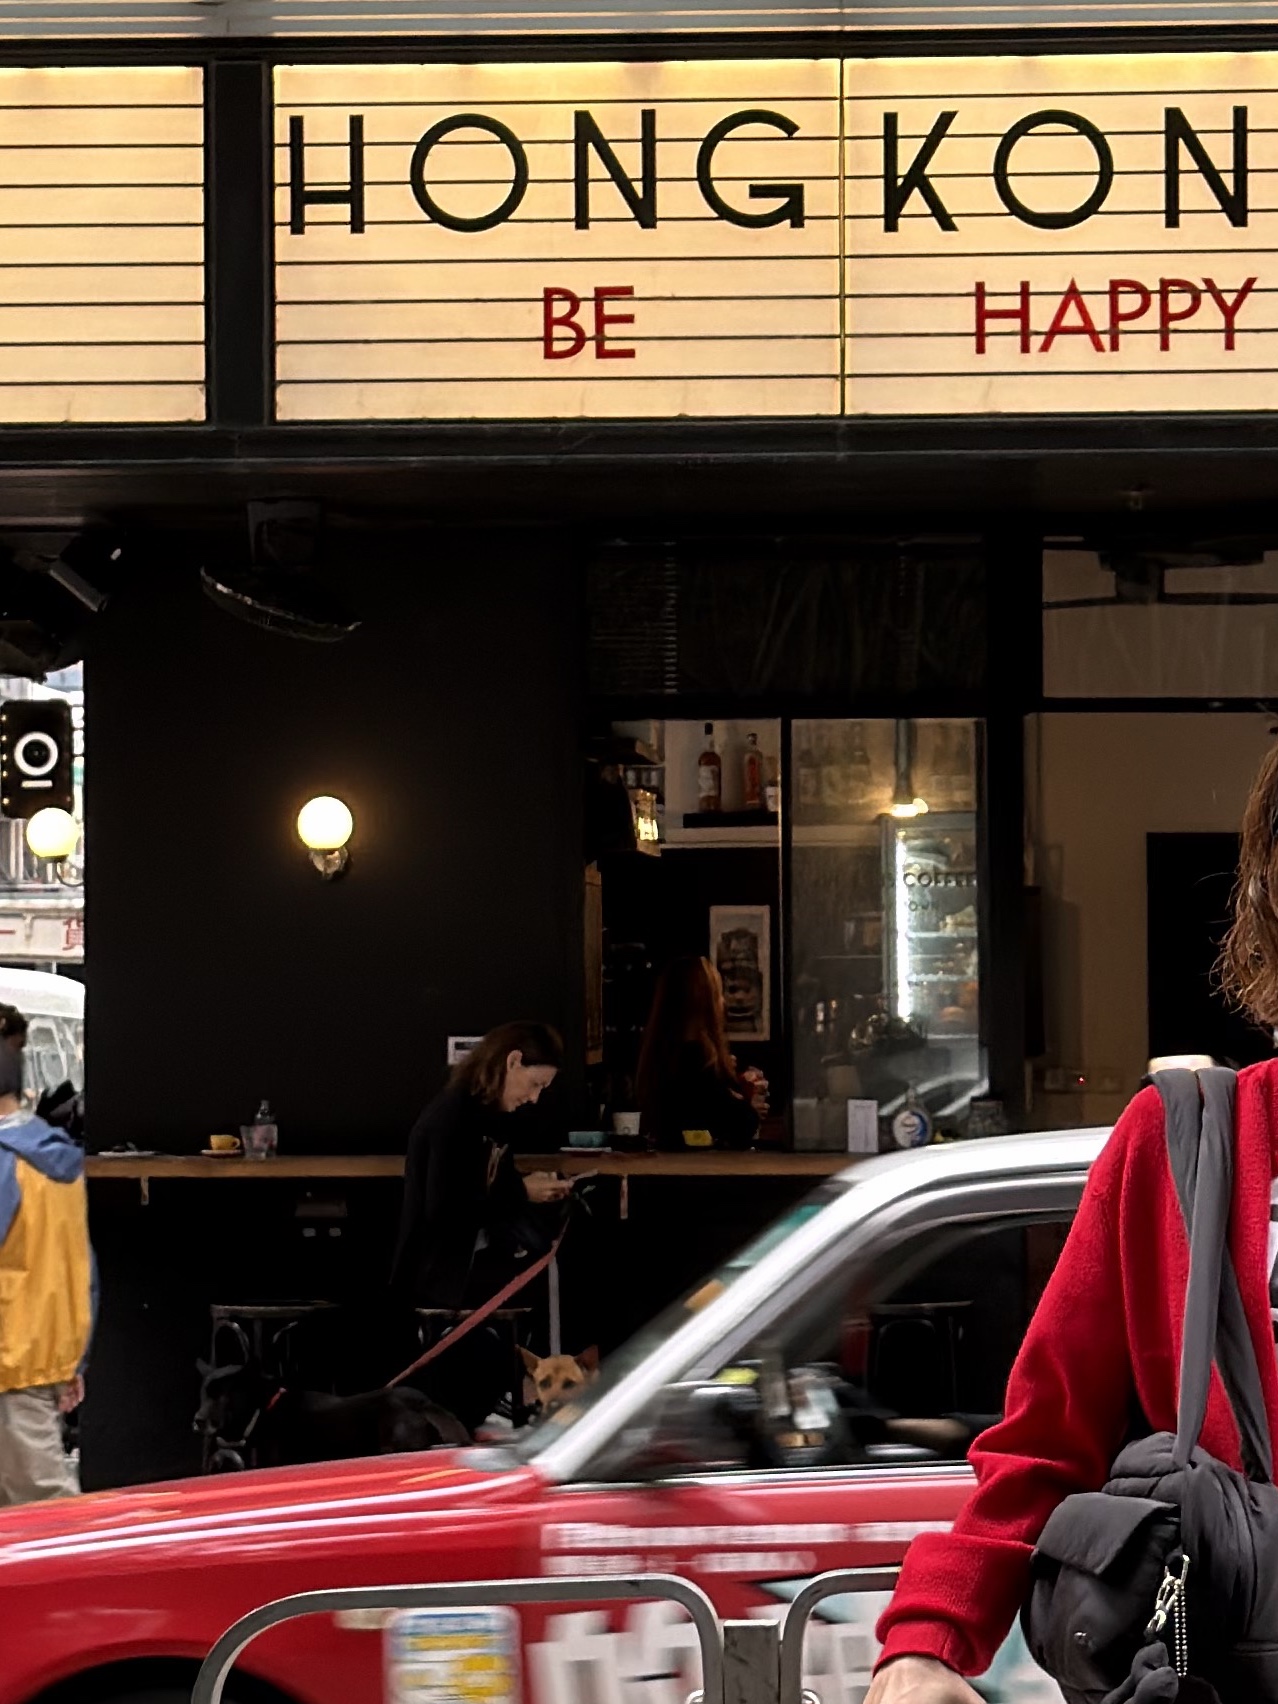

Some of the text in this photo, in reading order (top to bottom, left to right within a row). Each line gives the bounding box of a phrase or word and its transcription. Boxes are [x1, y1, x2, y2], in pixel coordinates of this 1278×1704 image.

[290, 109, 806, 235] HONG
[542, 276, 1258, 361] BE HAPPY
